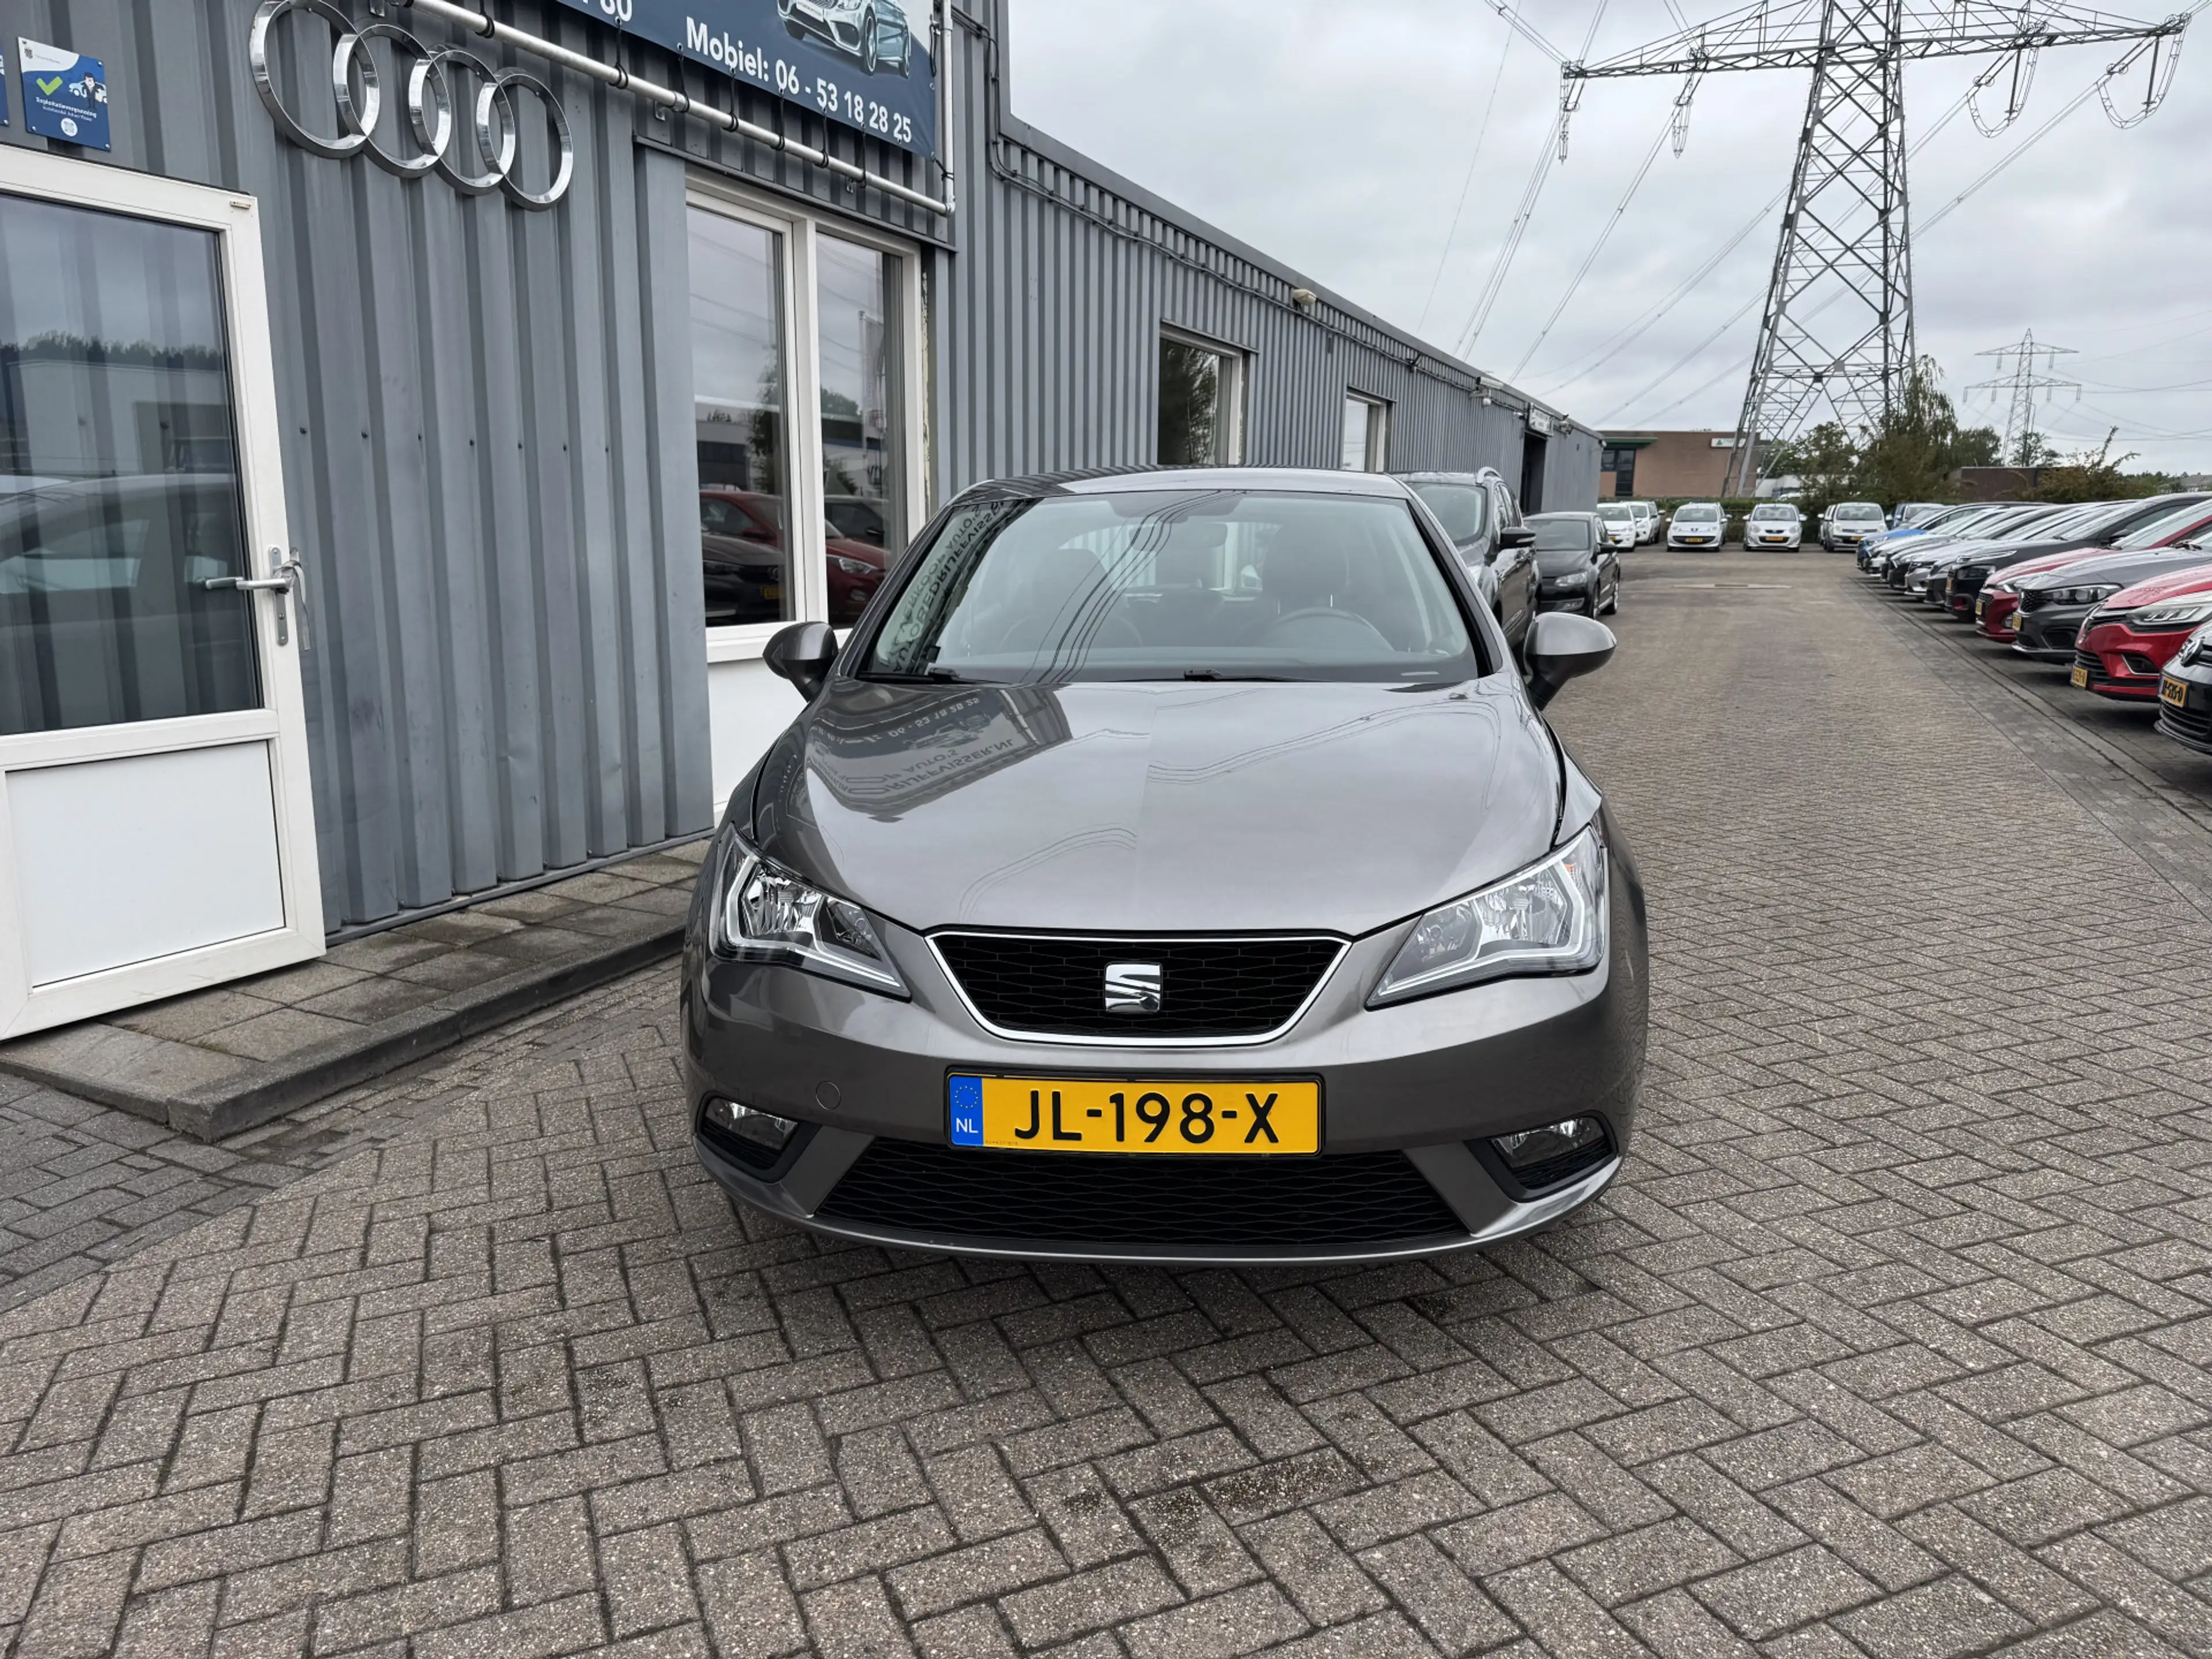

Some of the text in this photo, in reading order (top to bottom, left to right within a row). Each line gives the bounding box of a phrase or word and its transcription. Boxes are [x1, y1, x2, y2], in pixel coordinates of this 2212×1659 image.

[686, 16, 770, 82] Mobiel:
[775, 59, 800, 94] 06
[817, 77, 838, 112] 53
[844, 90, 864, 123] 18
[869, 101, 888, 133] 28
[893, 113, 912, 143] 25
[955, 1117, 978, 1134] NL
[1014, 1090, 1279, 1144] JL-198-X
